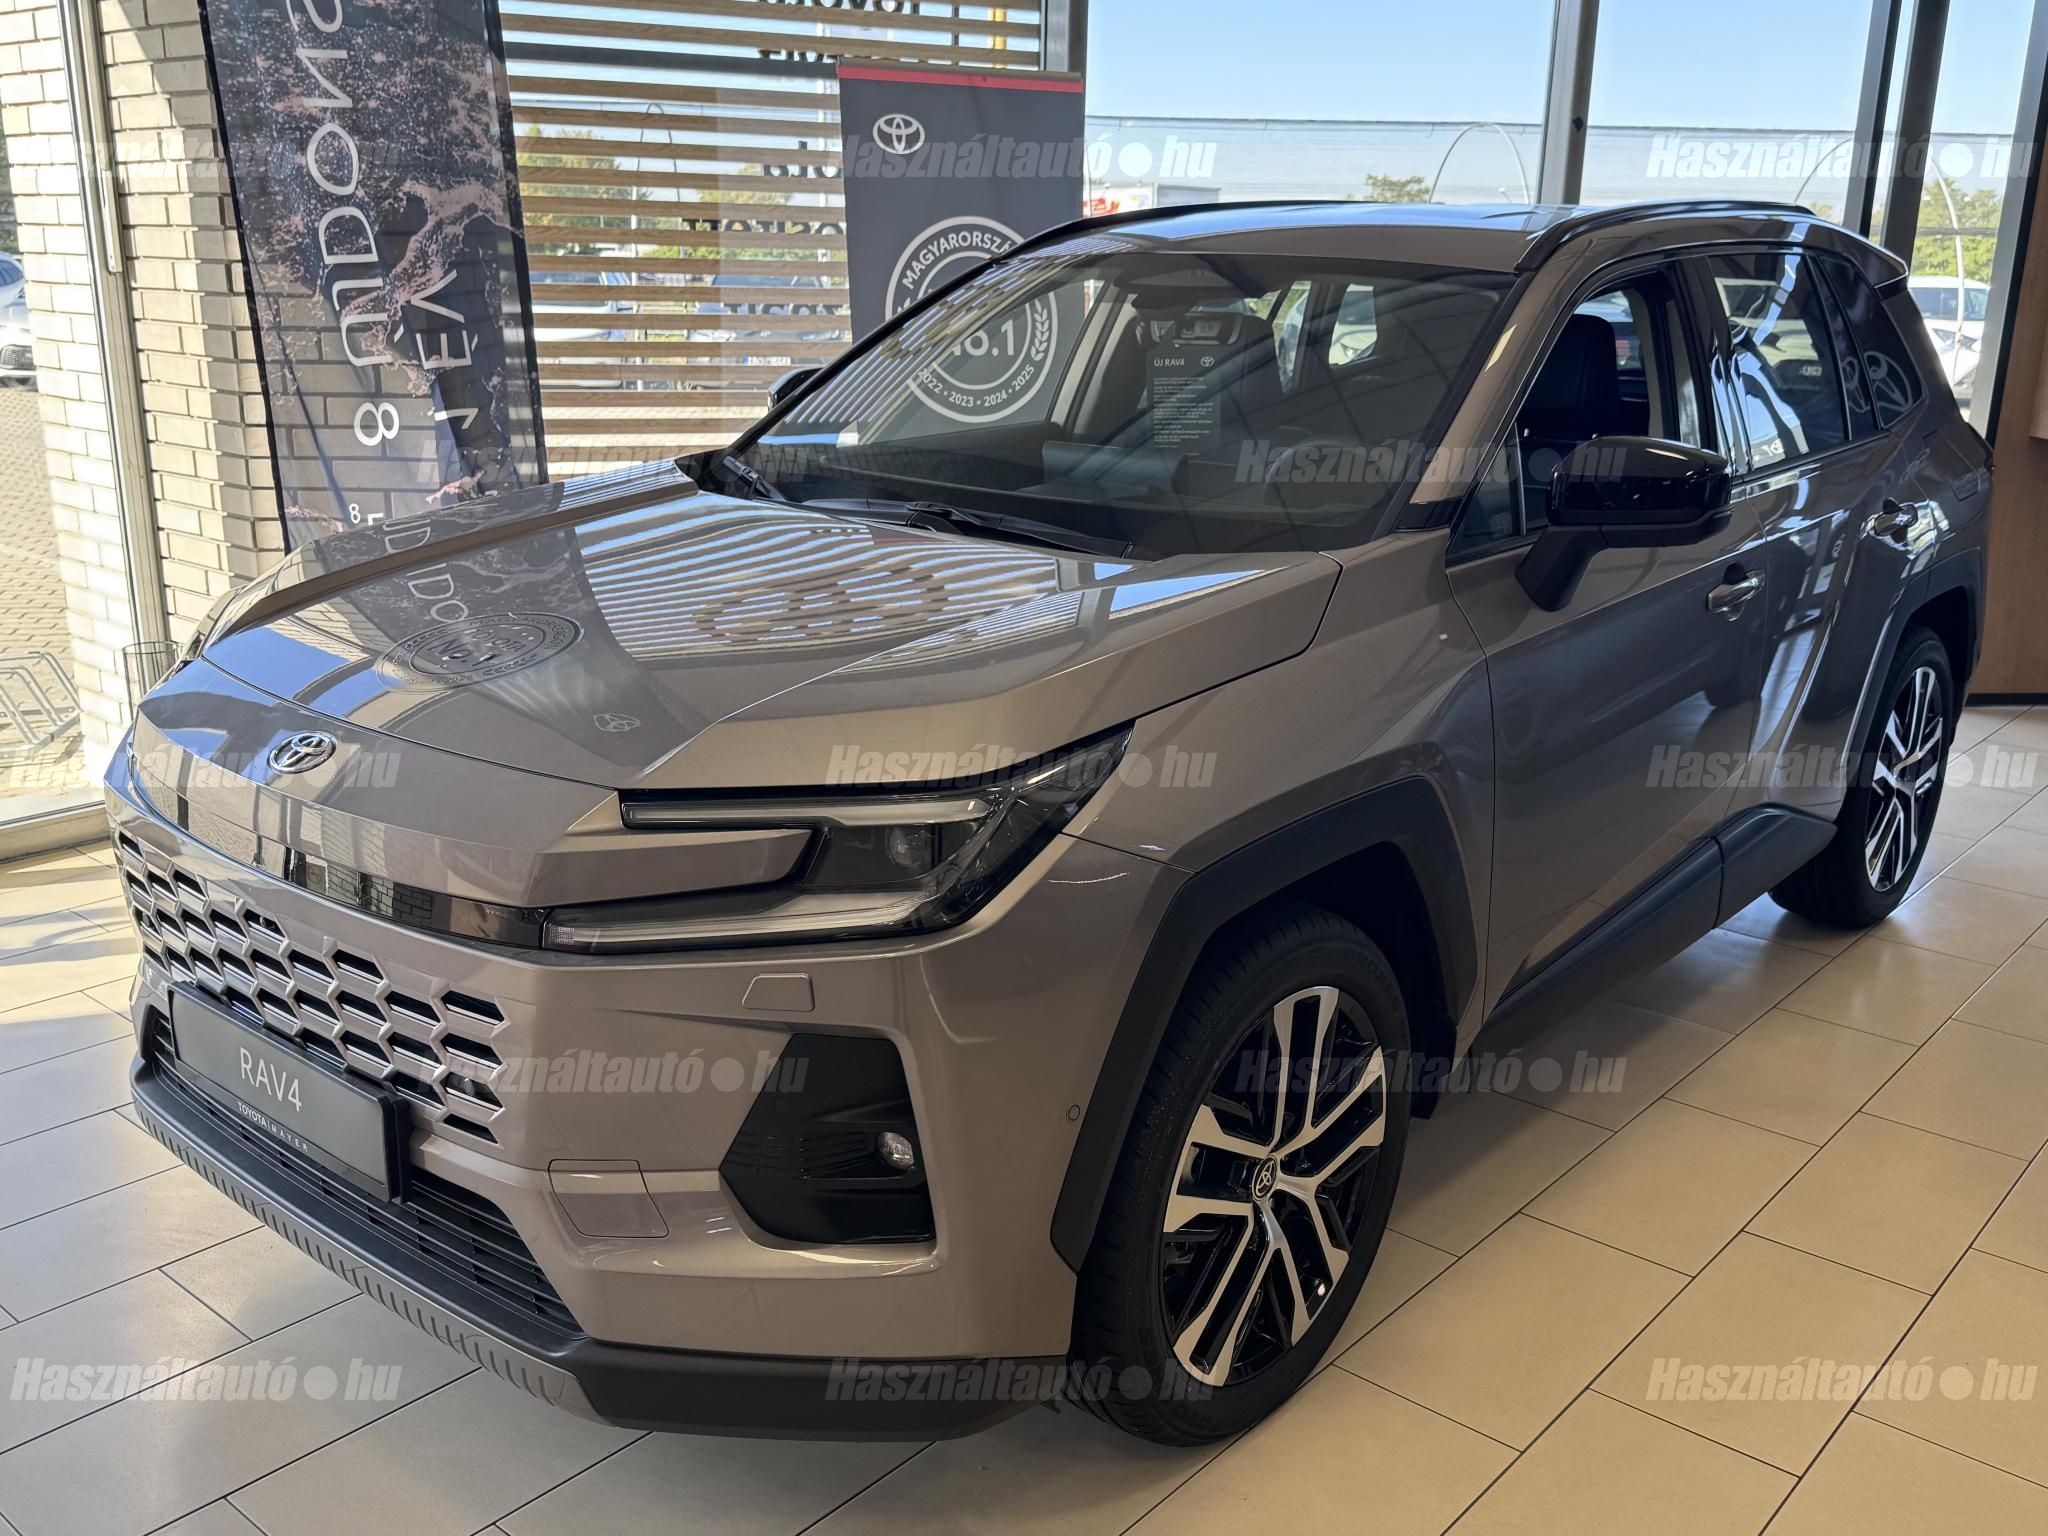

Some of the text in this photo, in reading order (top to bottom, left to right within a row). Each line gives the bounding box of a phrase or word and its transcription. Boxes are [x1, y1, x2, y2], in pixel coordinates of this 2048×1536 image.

[948, 390, 975, 408] 2023
[983, 388, 1009, 408] 2024
[1011, 363, 1036, 392] 2025
[1164, 357, 1185, 367] RAV4
[240, 1046, 302, 1112] RAV4
[237, 1101, 308, 1153] TOYOTA MAYER
